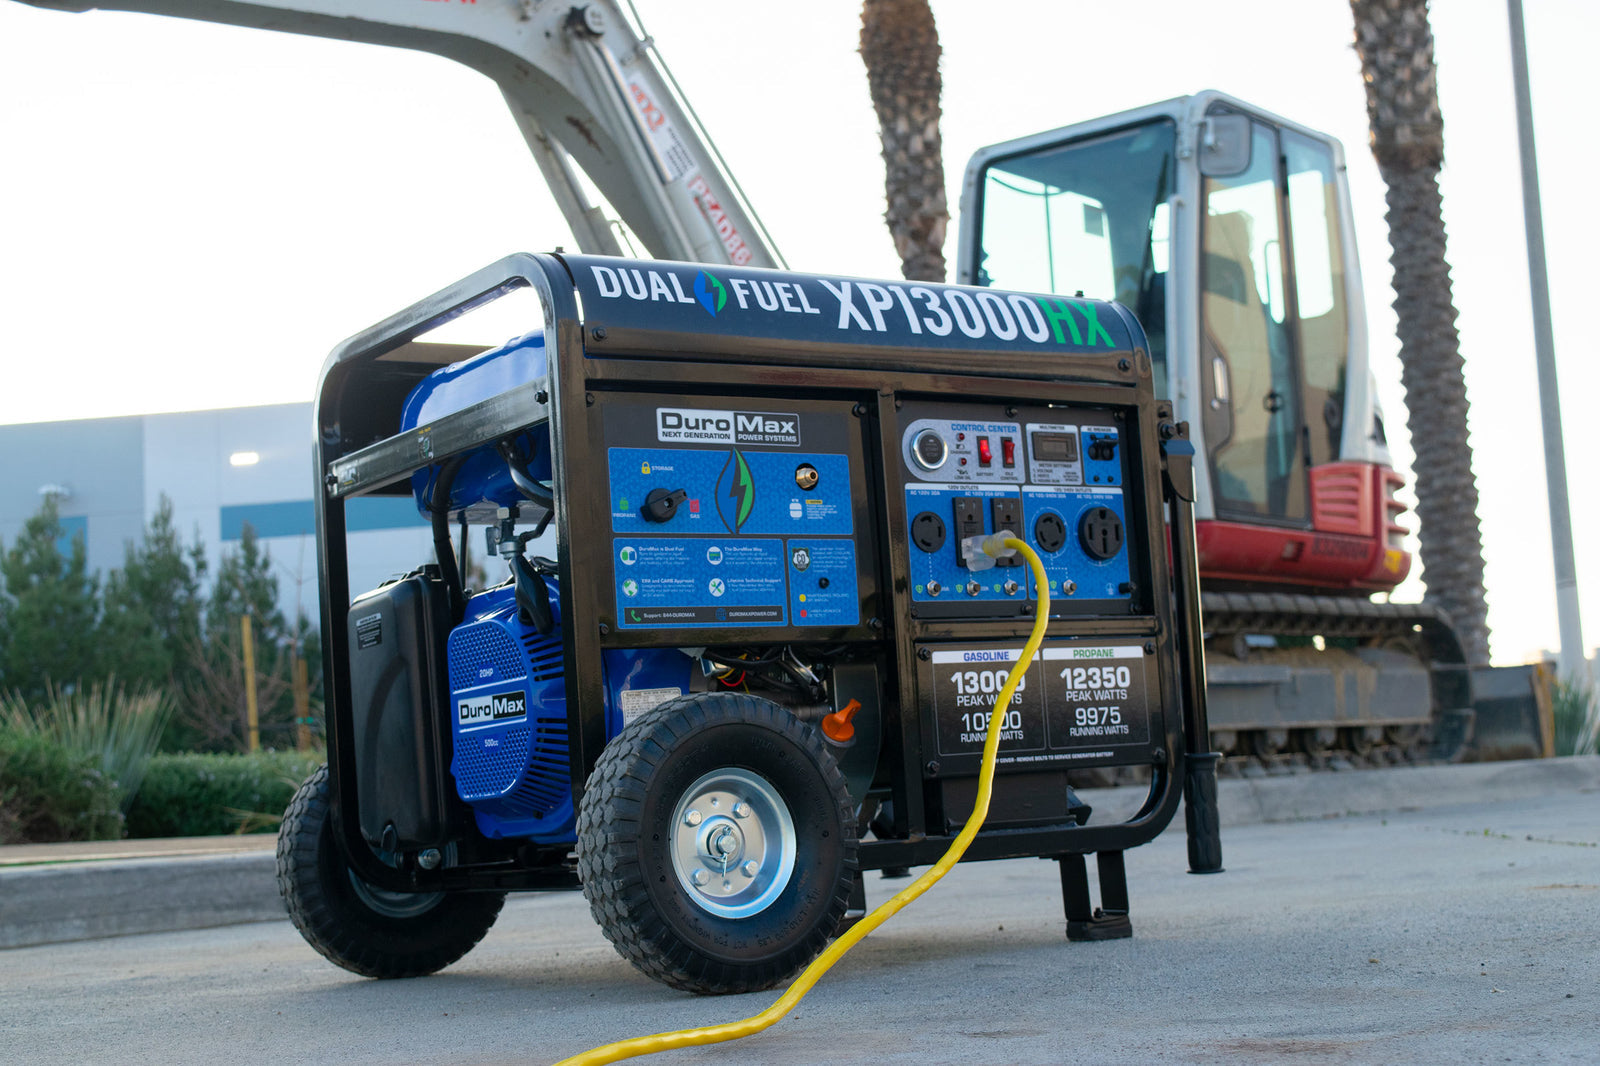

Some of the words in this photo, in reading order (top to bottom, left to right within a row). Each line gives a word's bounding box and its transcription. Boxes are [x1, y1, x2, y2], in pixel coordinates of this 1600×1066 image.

[591, 266, 695, 303] DUAL
[729, 279, 820, 315] FUEL
[818, 279, 1115, 348] XP13000HX
[951, 423, 987, 432] CONTROL
[988, 425, 1017, 433] CENTER
[684, 432, 731, 440] GENERATION
[738, 434, 763, 442] POWER
[764, 435, 797, 443] SYSTEMS
[963, 651, 1010, 661] GASOLINE
[1073, 649, 1114, 658] PROPANE
[479, 667, 494, 678] 20HP
[1060, 666, 1131, 690] 12350
[957, 696, 984, 707] PEAK
[986, 693, 1022, 706] WTS
[1066, 691, 1091, 702] PEAK
[1093, 689, 1128, 701] WATTS
[1075, 706, 1122, 726] 9975
[1069, 726, 1104, 737] RUNNING
[1105, 724, 1129, 735] WATTS
[484, 739, 499, 748] 500cc
